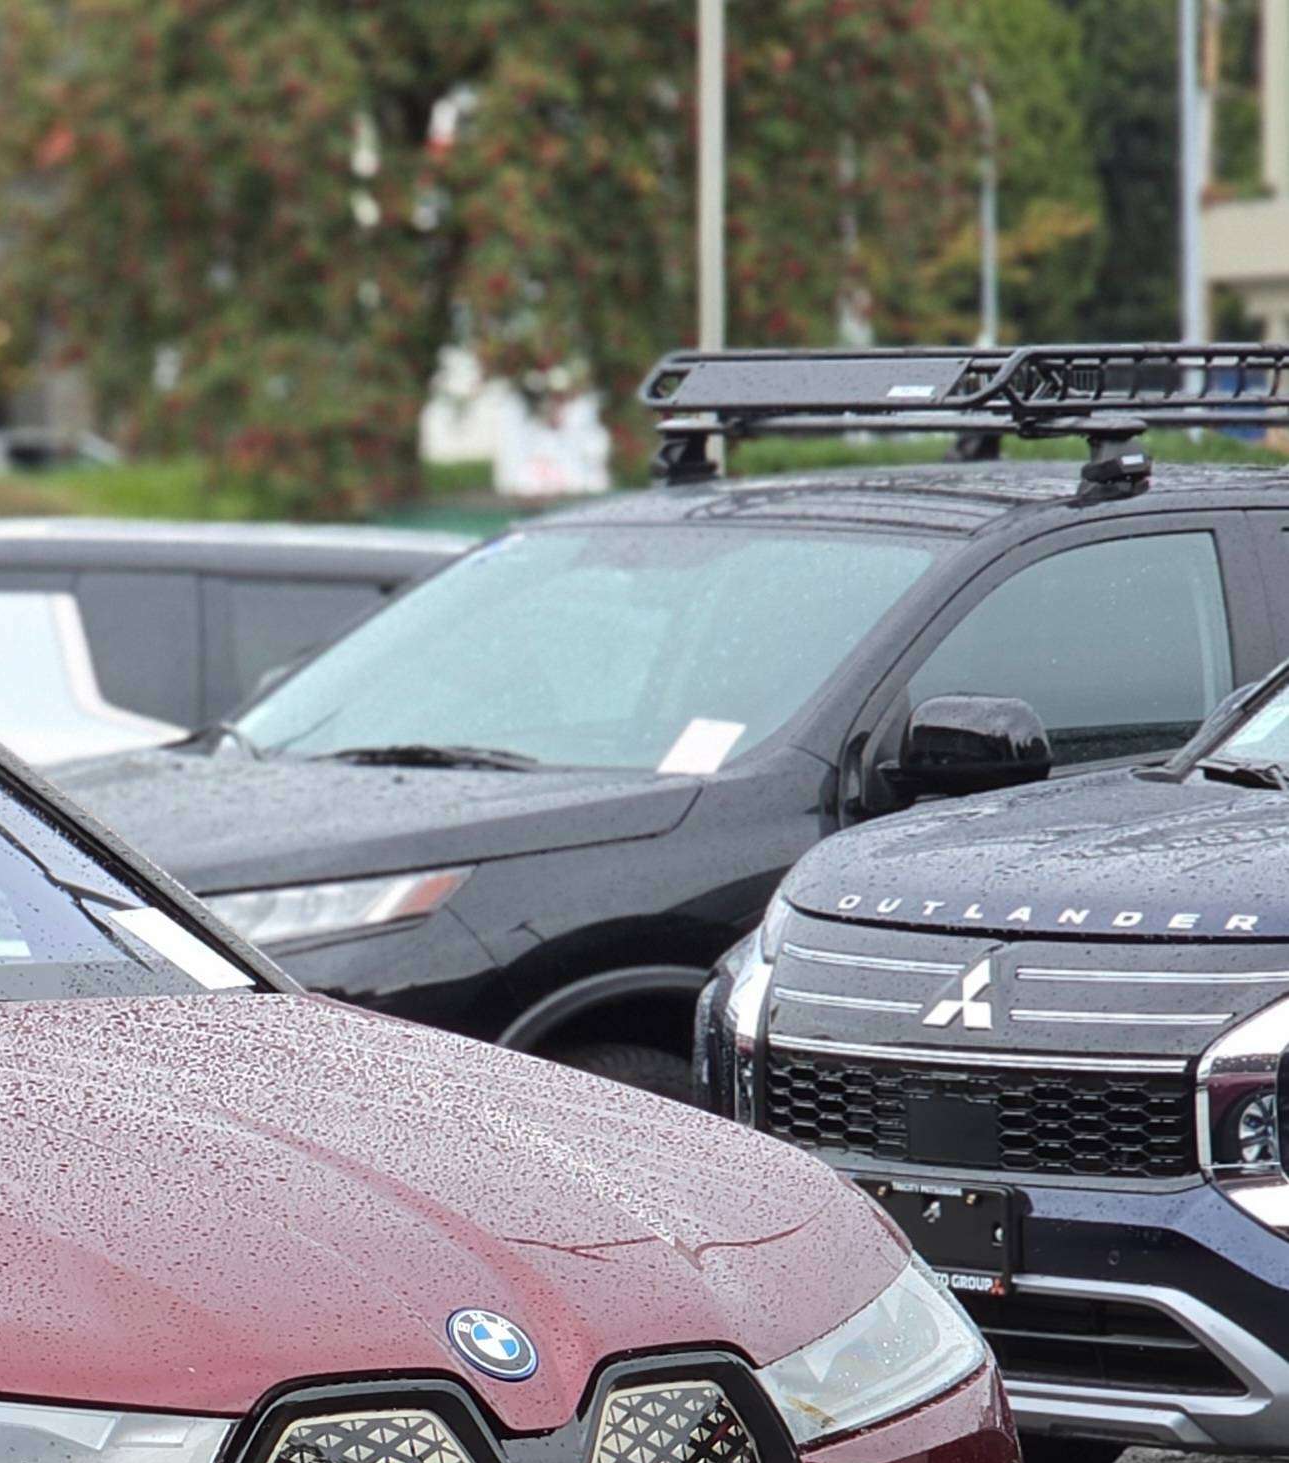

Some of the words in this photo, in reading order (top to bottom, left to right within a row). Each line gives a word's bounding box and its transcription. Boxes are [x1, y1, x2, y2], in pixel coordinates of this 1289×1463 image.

[837, 894, 1259, 931] OUTLANDER
[951, 1273, 993, 1292] GROUP
[457, 1311, 512, 1334] BMW
